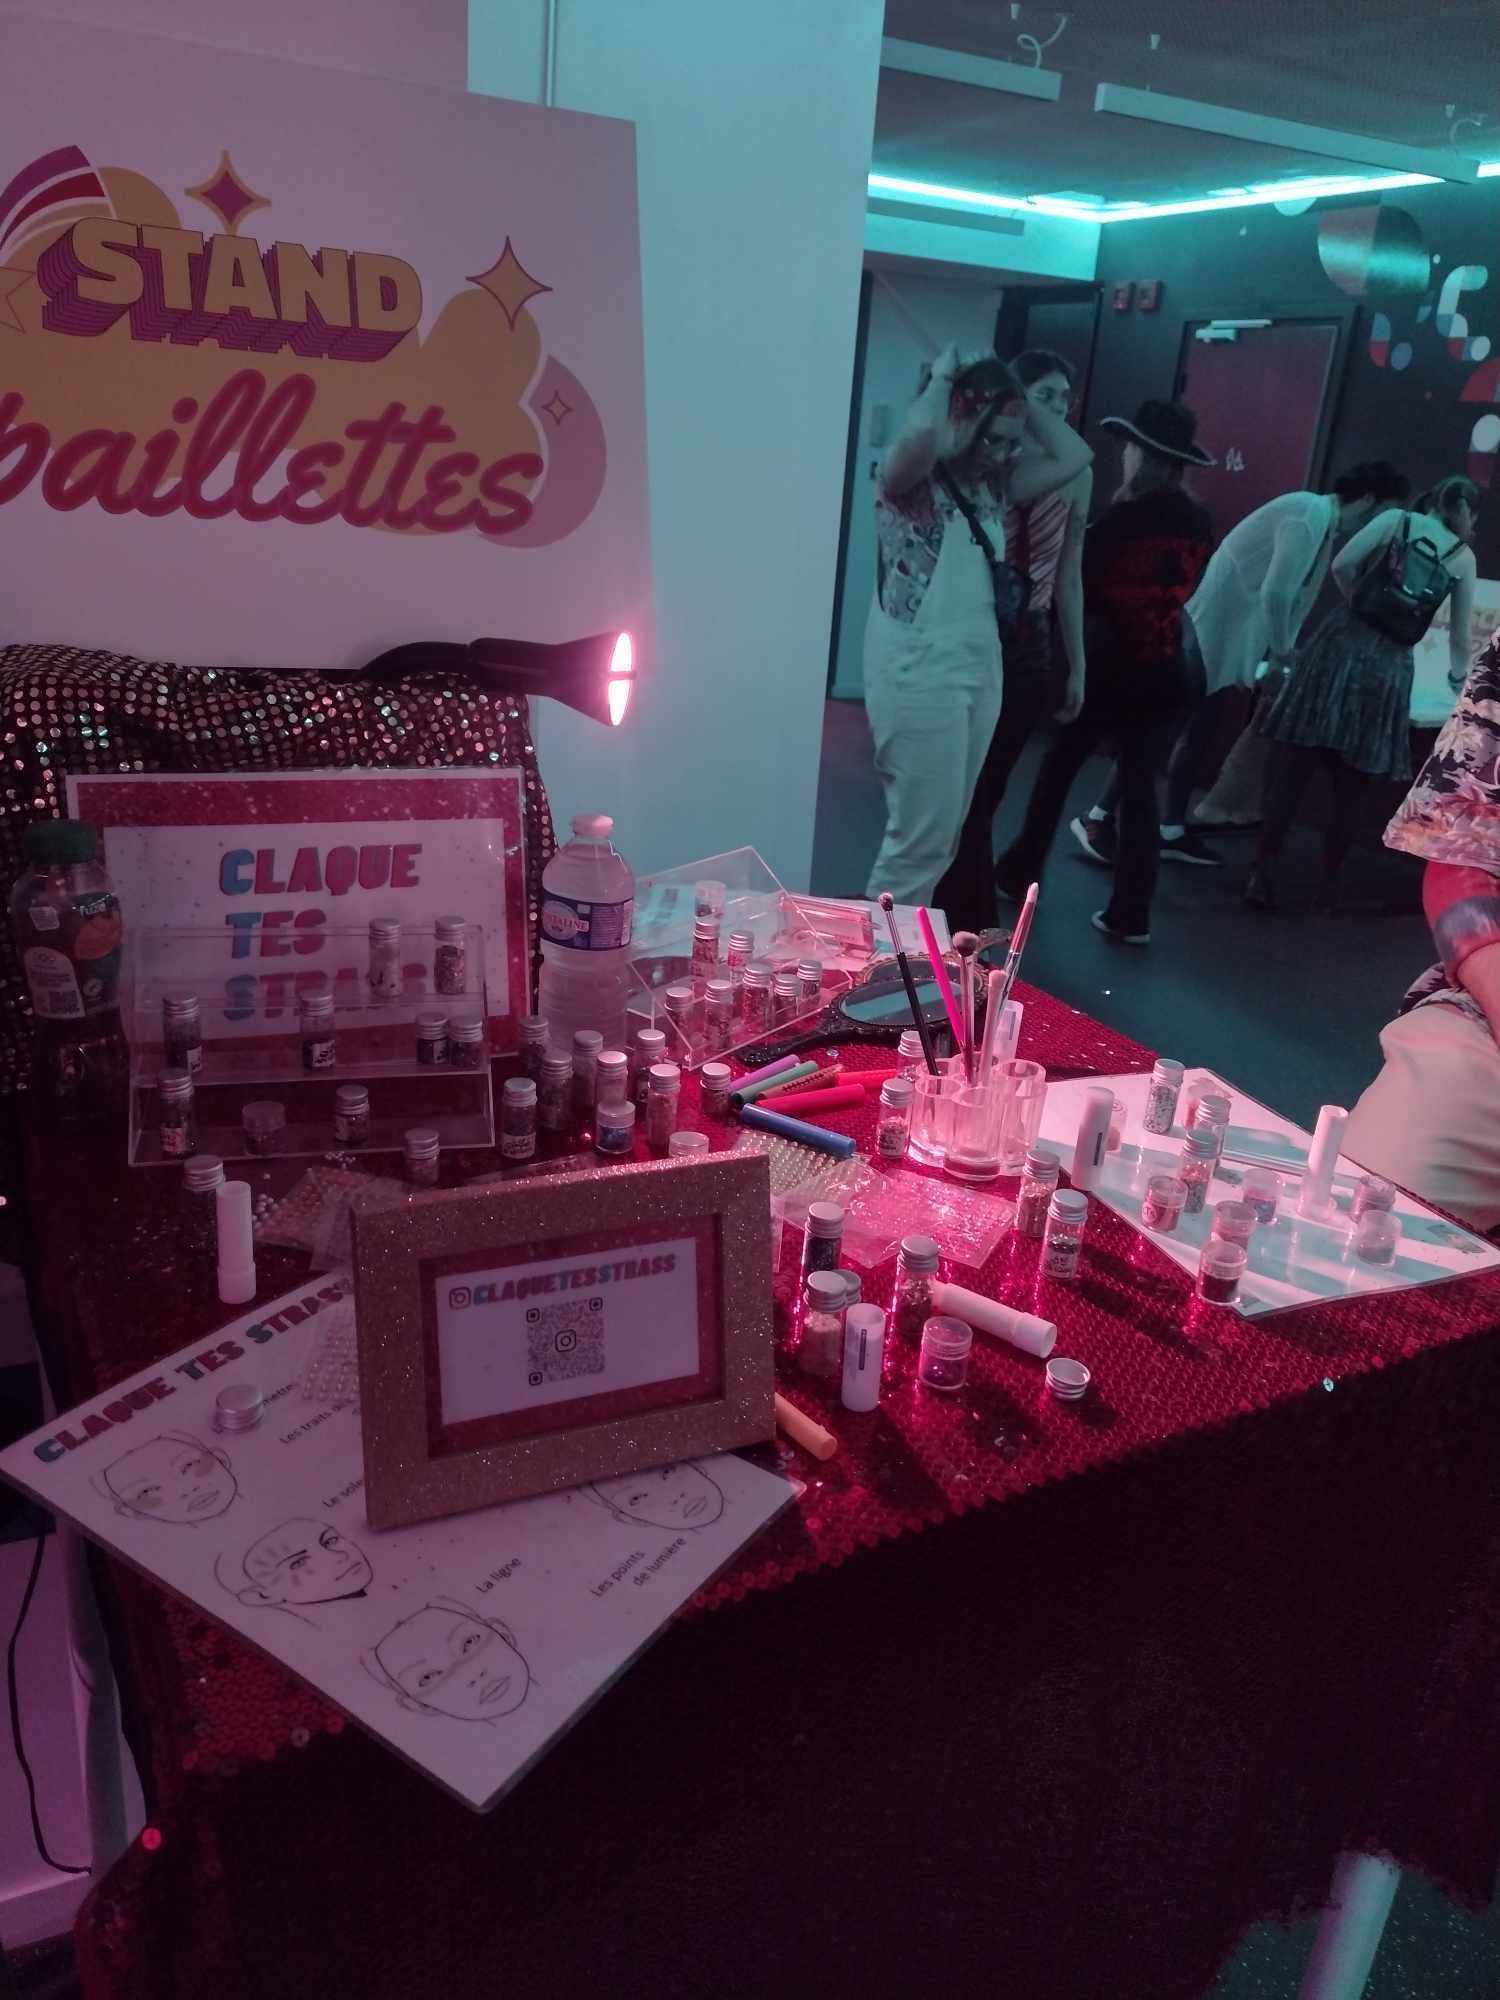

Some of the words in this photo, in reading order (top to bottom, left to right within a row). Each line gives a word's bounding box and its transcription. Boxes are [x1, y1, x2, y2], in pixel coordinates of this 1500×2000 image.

[39, 216, 423, 361] STAND
[219, 843, 423, 896] CLAQUE
[224, 908, 327, 960] TES
[473, 1253, 677, 1306] CLAQUETESSTRASS
[33, 1376, 176, 1463] CLAQUE
[174, 1340, 245, 1381] TES
[475, 1577, 495, 1594] La
[489, 1556, 523, 1581] ligne
[590, 1579, 614, 1598] Les
[610, 1549, 646, 1583] points
[632, 1569, 651, 1587] de
[646, 1536, 687, 1575] lumière
